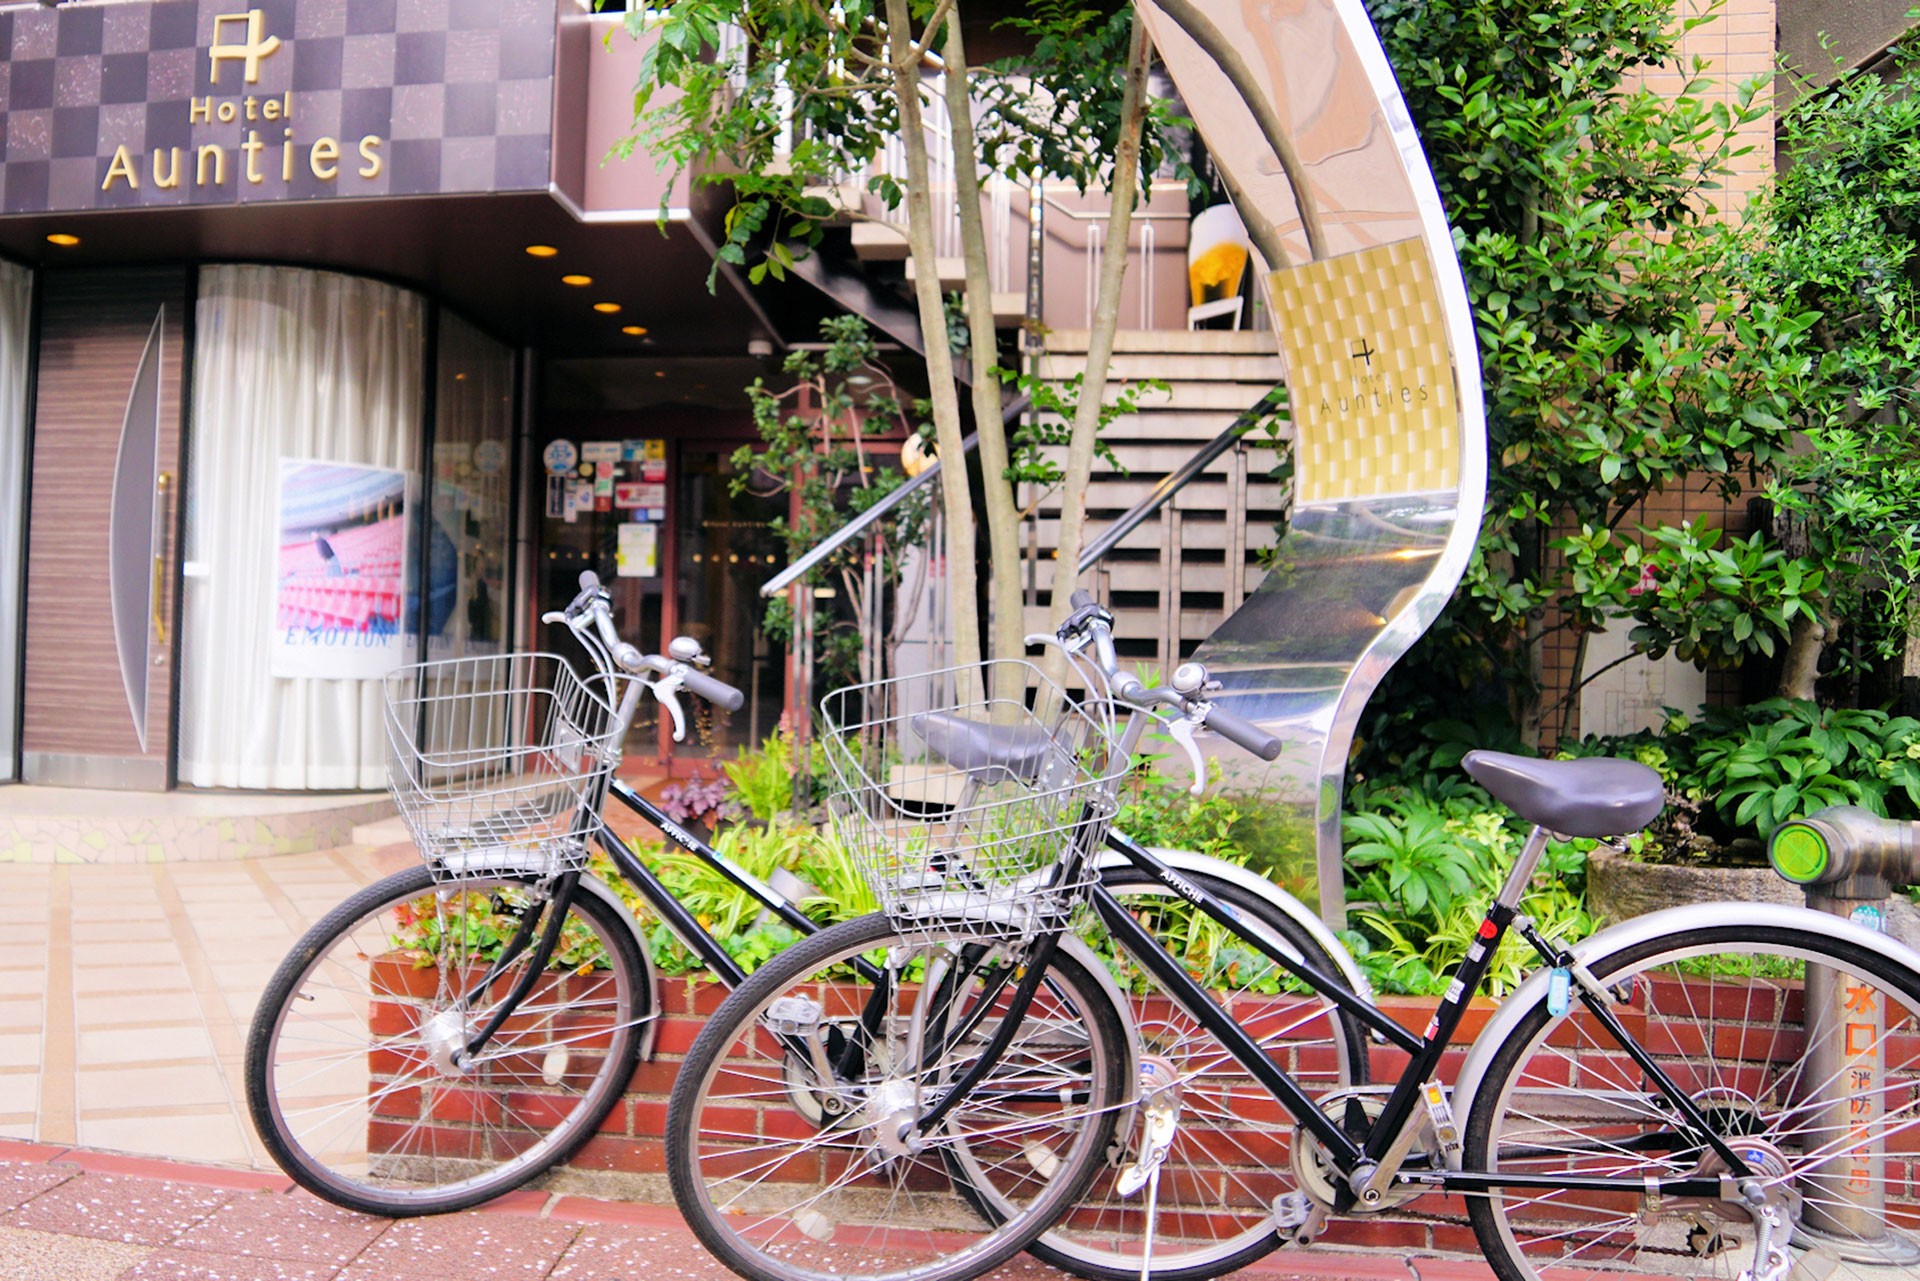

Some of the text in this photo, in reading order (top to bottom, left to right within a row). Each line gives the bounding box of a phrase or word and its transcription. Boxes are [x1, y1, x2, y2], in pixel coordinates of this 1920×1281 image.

[189, 90, 293, 124] Hotel
[101, 127, 384, 191] Aunties
[1320, 384, 1428, 415] Aunties
[1160, 870, 1205, 904] AFFICHE
